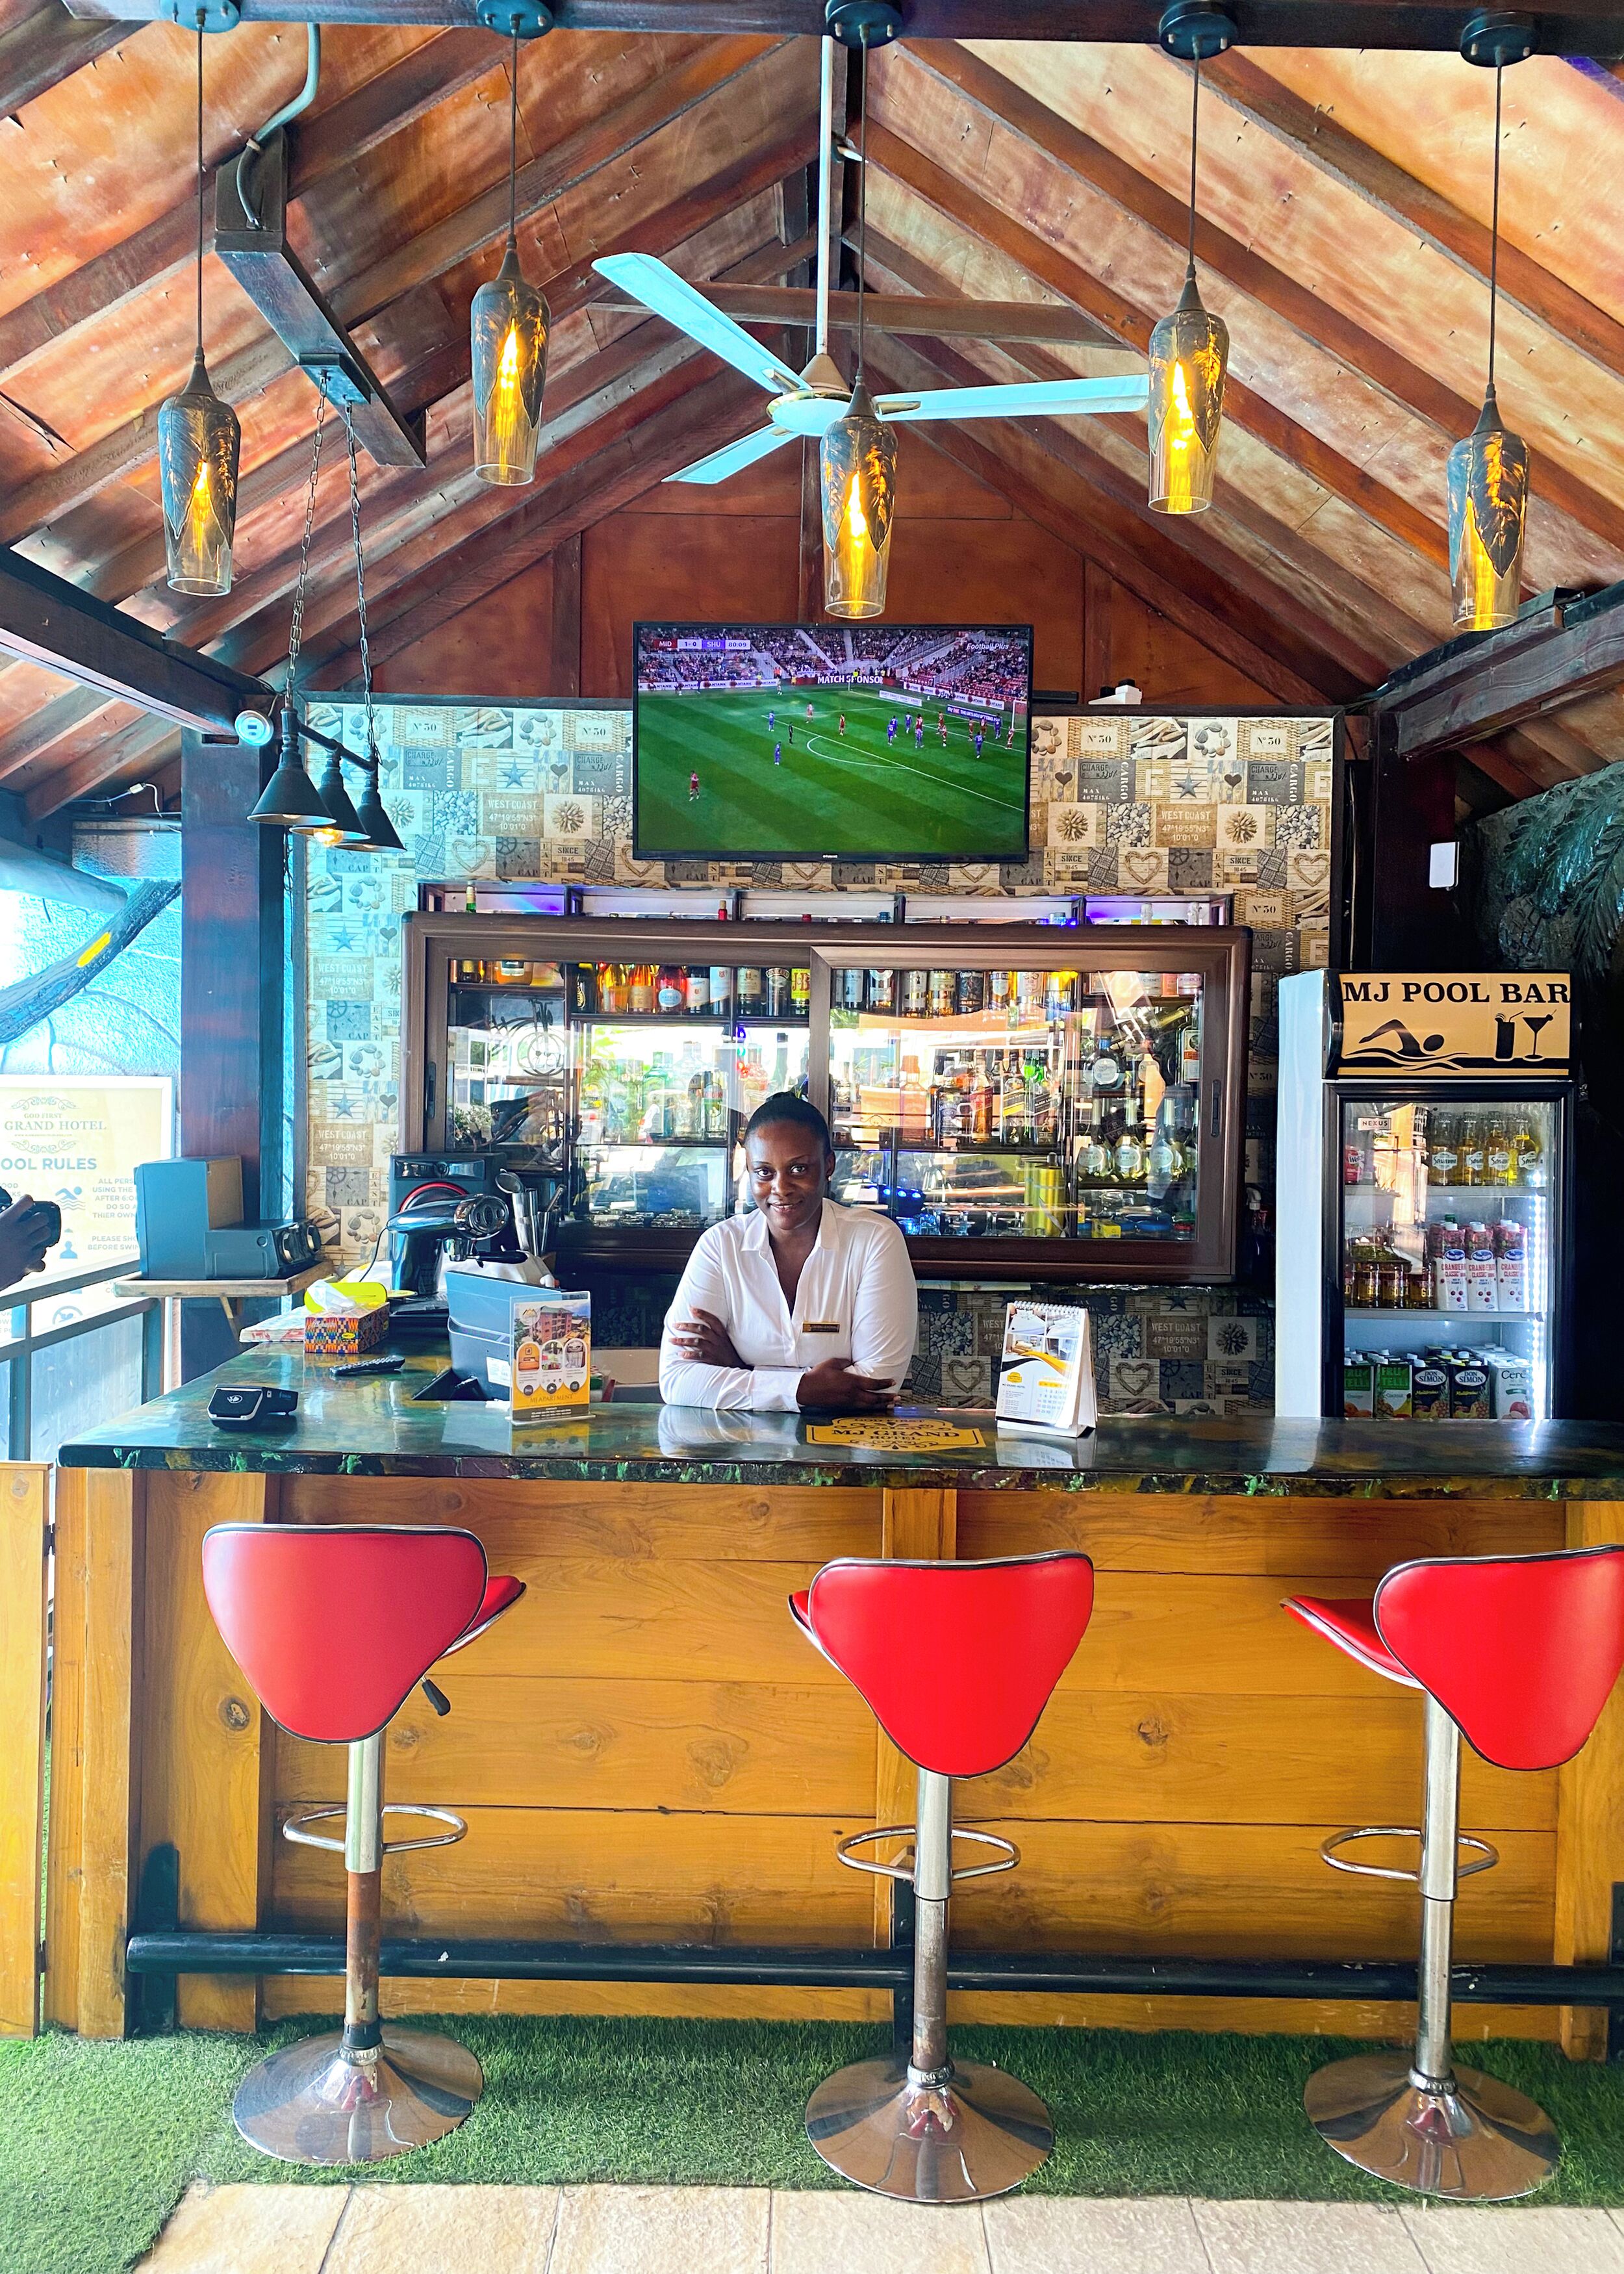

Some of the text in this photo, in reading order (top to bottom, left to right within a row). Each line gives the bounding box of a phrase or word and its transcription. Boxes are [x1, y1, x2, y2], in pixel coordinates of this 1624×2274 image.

[817, 674, 883, 684] MATCH SPONSOR
[407, 750, 435, 759] CHARGE
[446, 750, 455, 787] CARGO
[616, 754, 624, 793] CARGO
[1120, 761, 1129, 800] CARGO
[1289, 763, 1299, 802] CARGO
[488, 800, 537, 810] WEST COAST
[1161, 811, 1210, 820] WEST COAST
[1285, 931, 1294, 969] CARGO
[318, 964, 367, 973] WEST COAST
[1343, 982, 1571, 1003] MJ POOL BAR
[5, 1121, 107, 1130] GRAND HOTEL
[318, 1131, 367, 1139] WEST COAST
[1, 1158, 97, 1169] OOL RULES
[983, 1320, 1004, 1328] WEST
[1152, 1322, 1200, 1331] WEST COAST
[538, 1394, 572, 1403] APARTMENT
